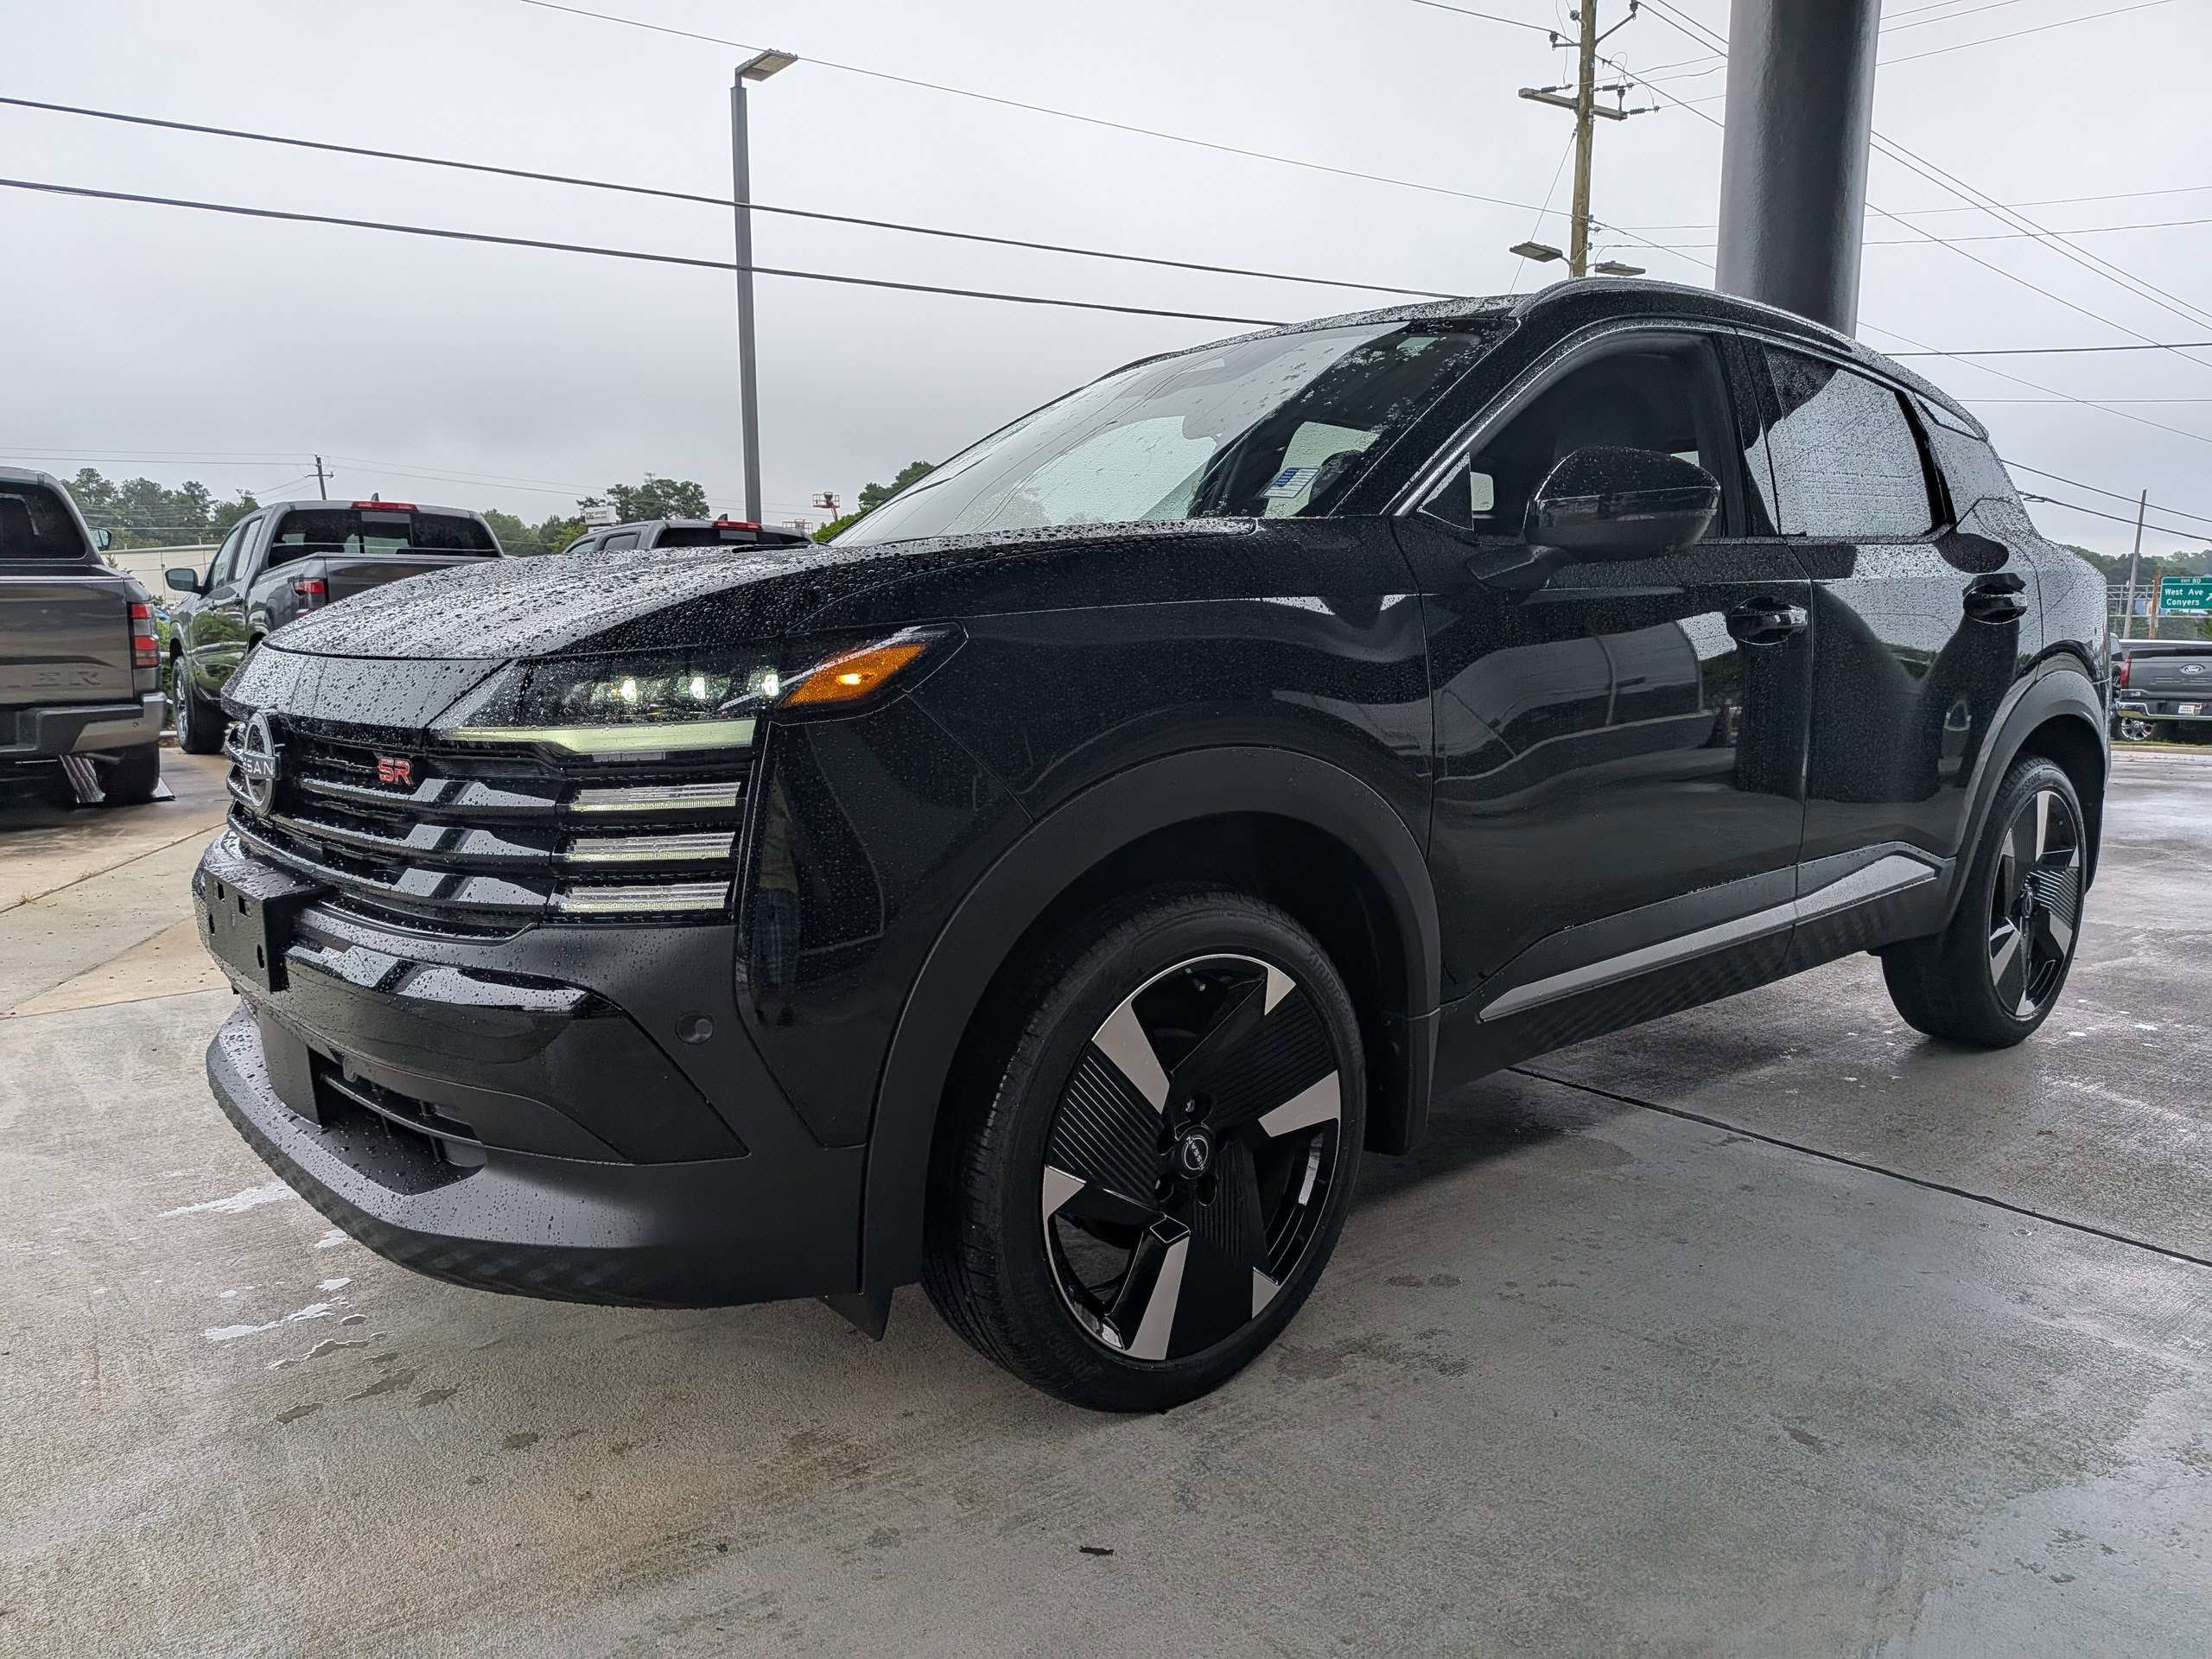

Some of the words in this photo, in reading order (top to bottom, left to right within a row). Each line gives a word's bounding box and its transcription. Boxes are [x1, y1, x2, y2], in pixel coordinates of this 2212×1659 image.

[2166, 598, 2200, 607] Conyers
[378, 757, 411, 785] SR
[1185, 1135, 1205, 1171] NISSAN
